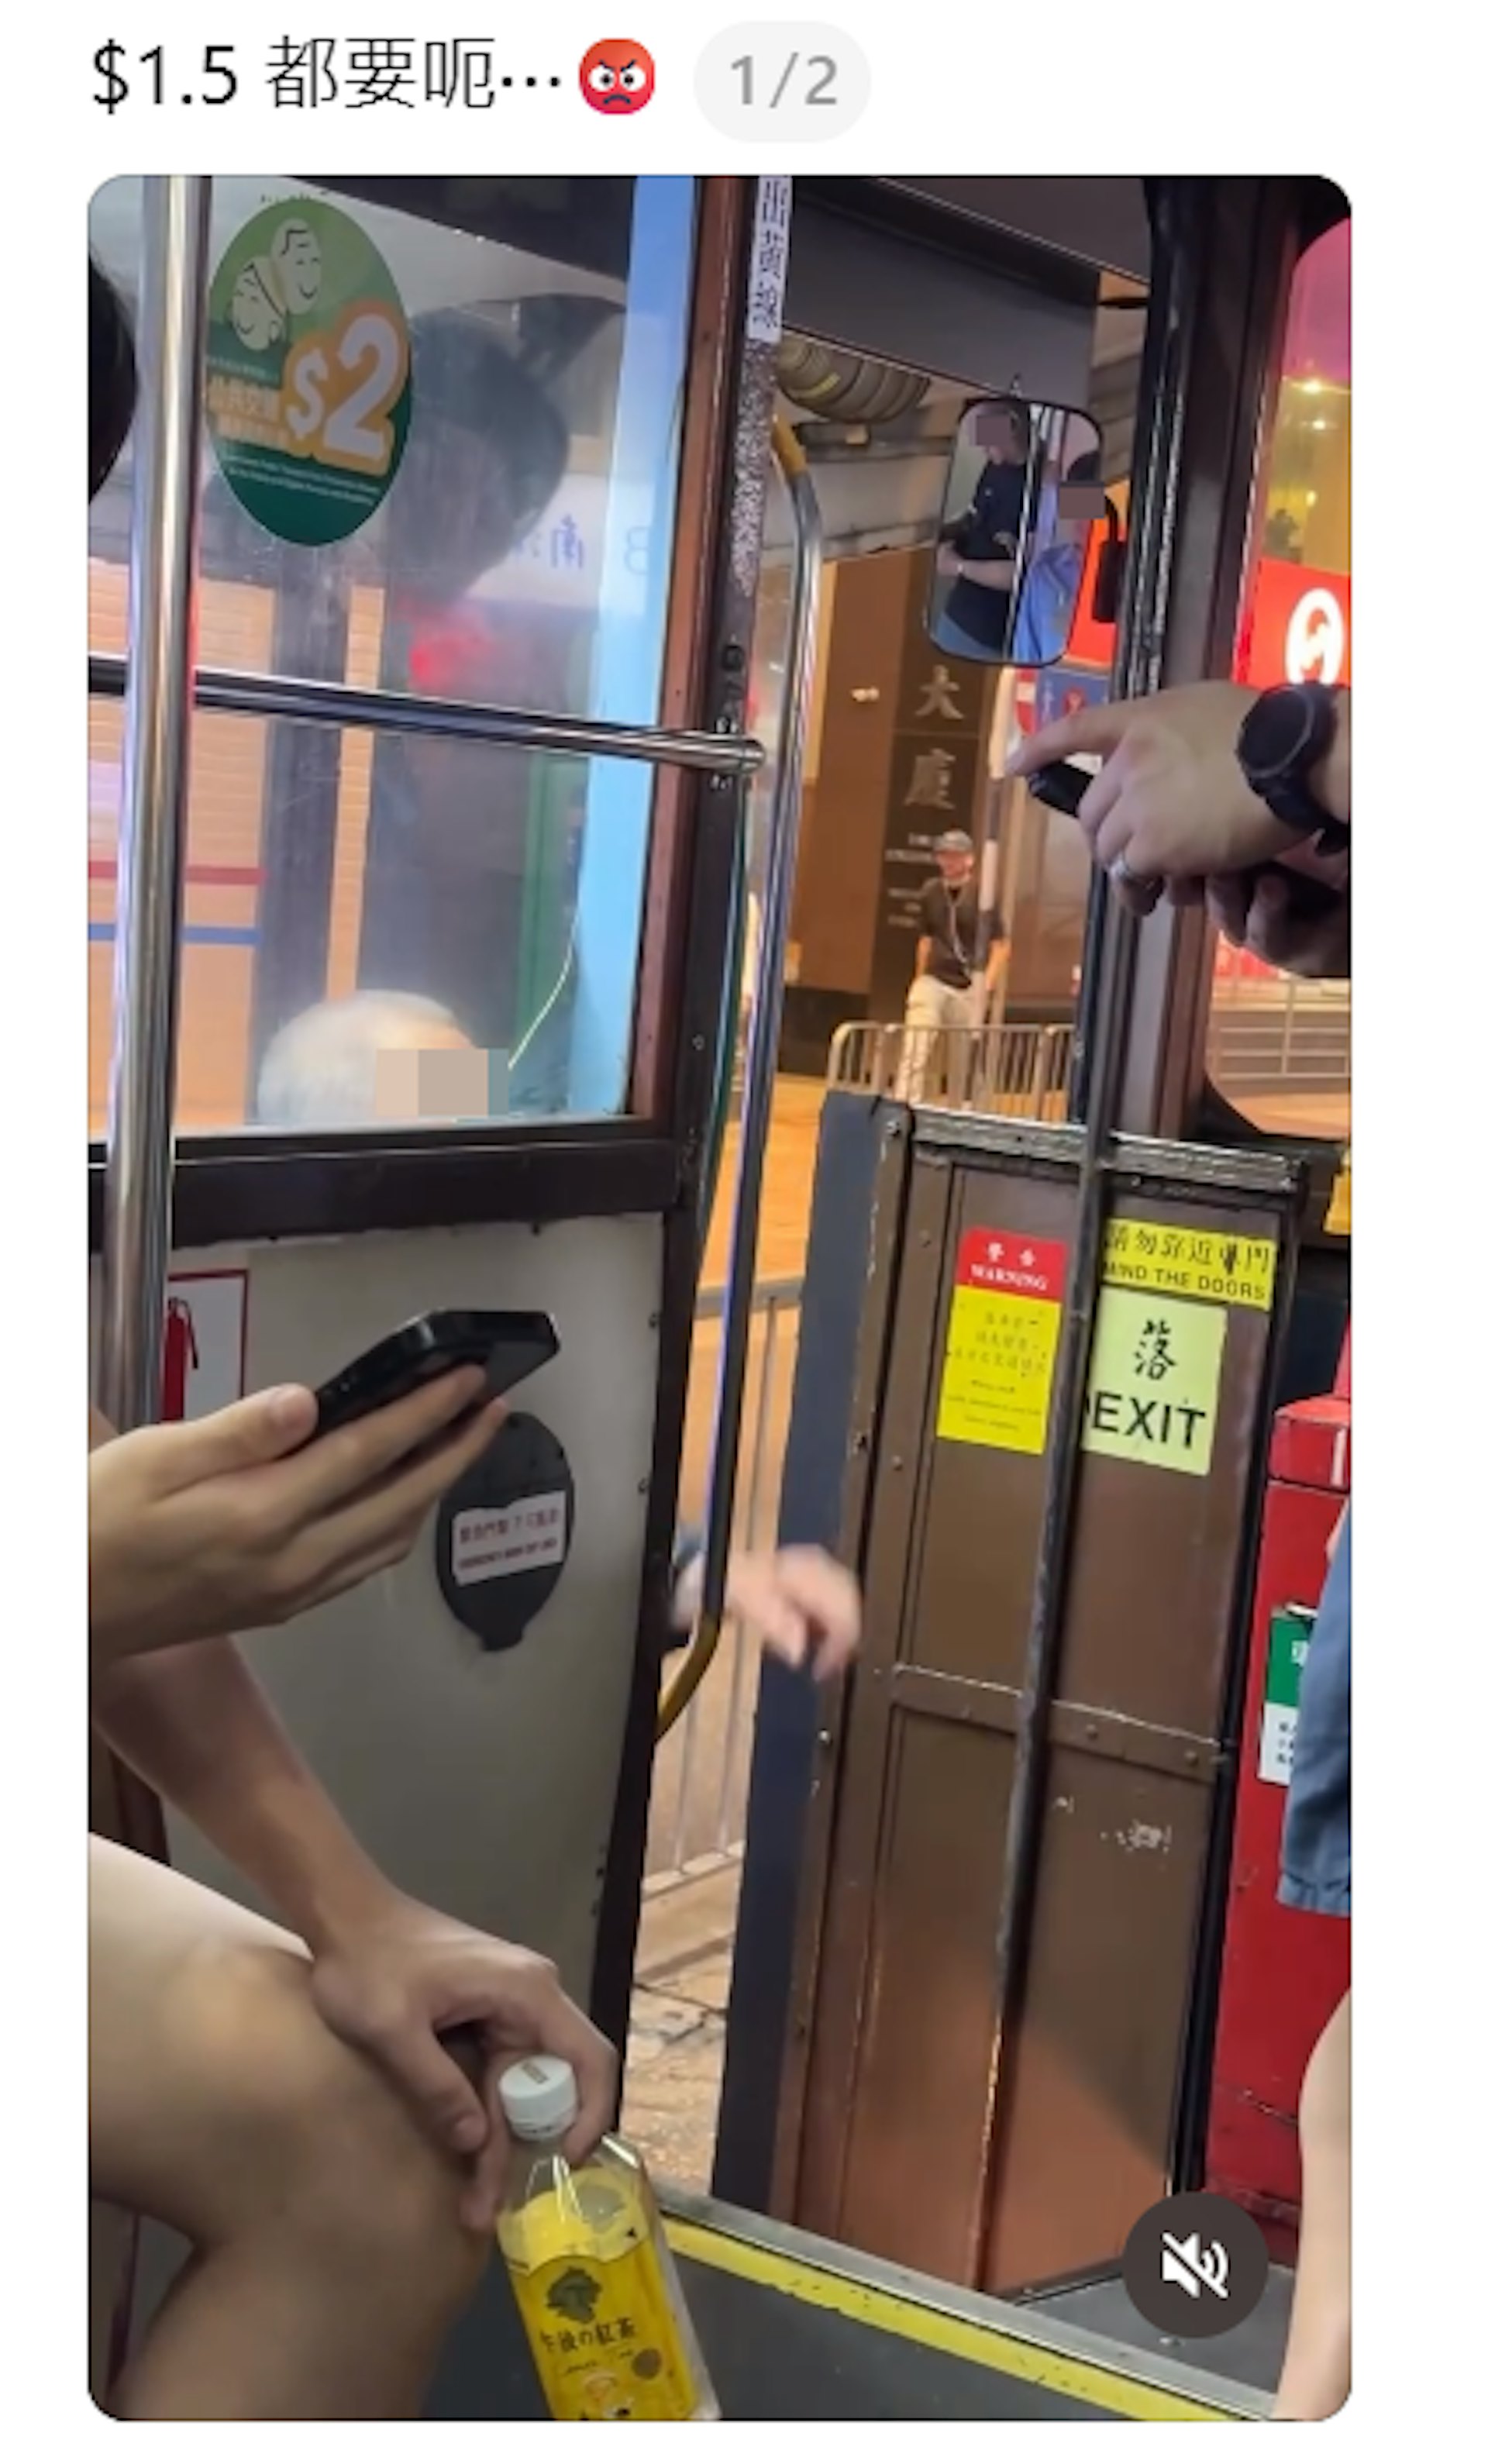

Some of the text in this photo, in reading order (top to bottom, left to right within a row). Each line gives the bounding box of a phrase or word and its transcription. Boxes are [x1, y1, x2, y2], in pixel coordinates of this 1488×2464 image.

[286, 312, 400, 460] $2
[970, 1263, 1049, 1291] WARNING
[1154, 1268, 1190, 1287] THE
[1198, 1275, 1266, 1301] DOORS
[1134, 1319, 1177, 1380] 落
[1093, 1391, 1207, 1449] EXIT
